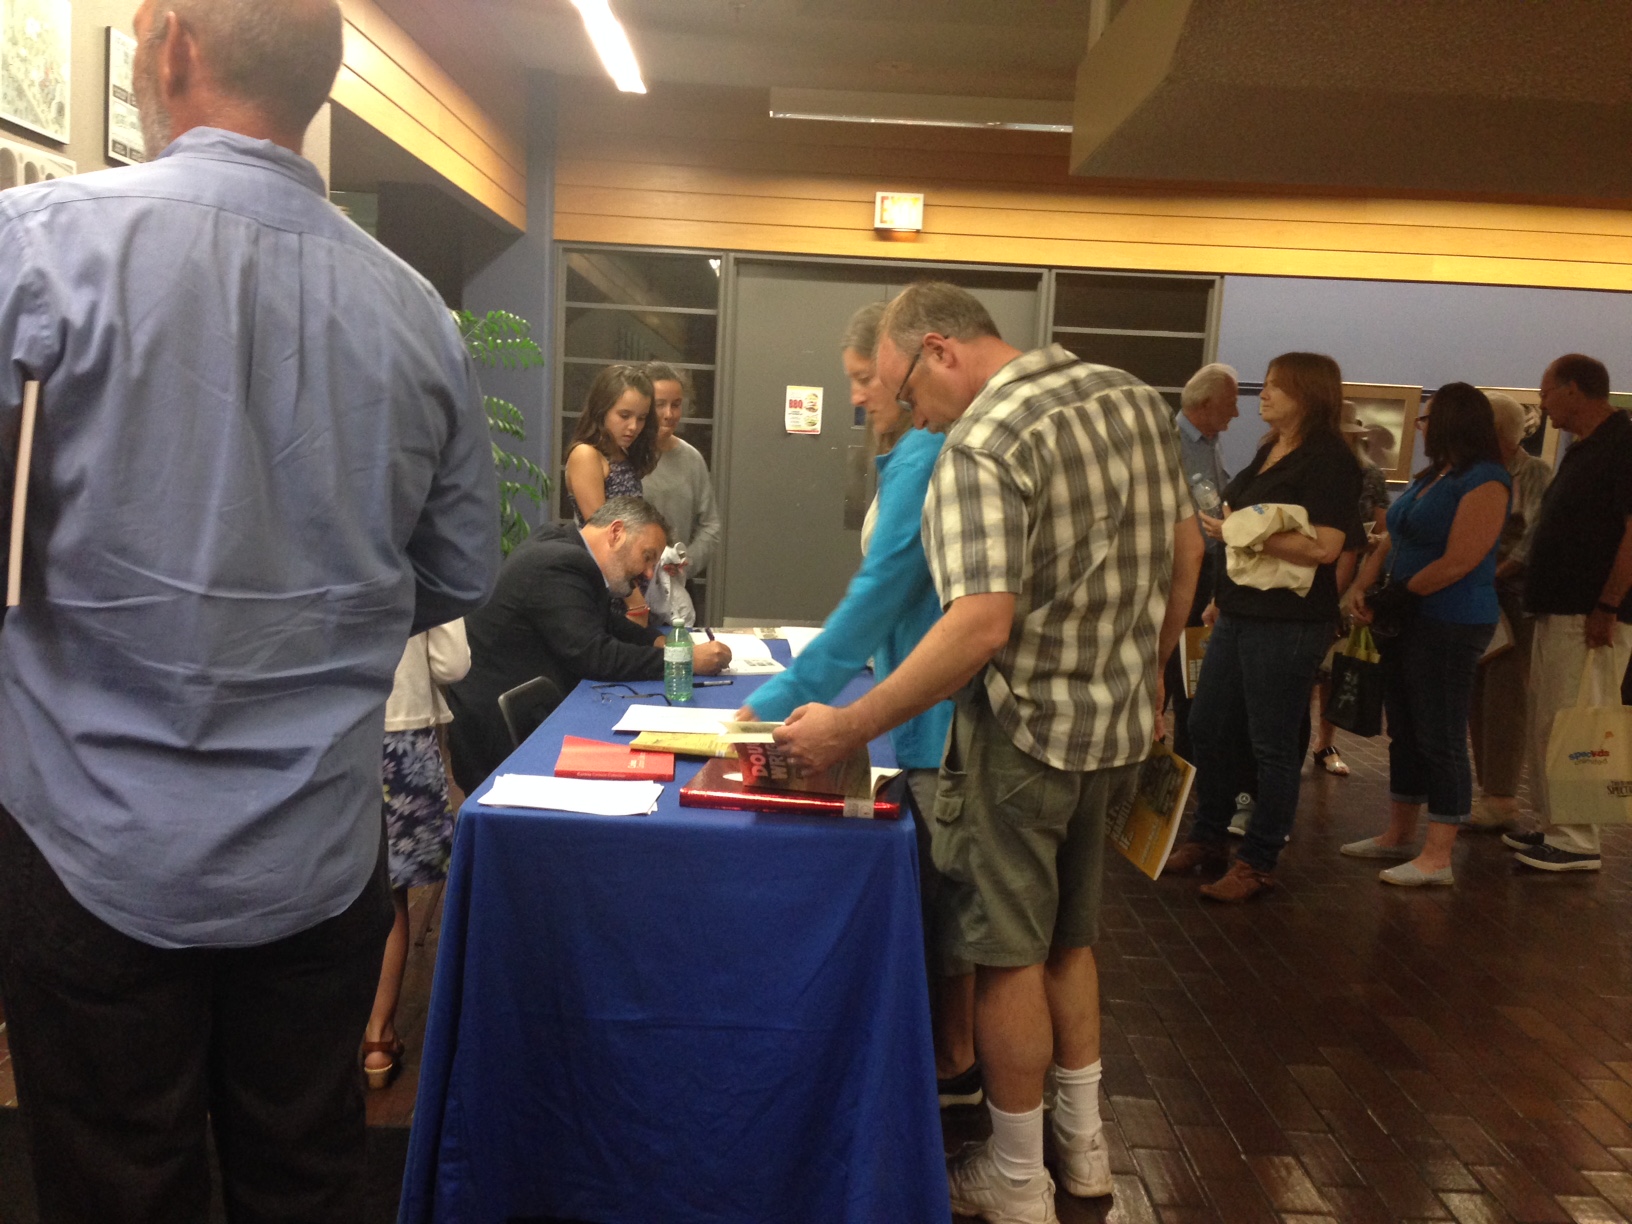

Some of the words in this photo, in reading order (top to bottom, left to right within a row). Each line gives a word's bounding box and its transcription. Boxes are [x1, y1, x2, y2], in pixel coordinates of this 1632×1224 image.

[880, 196, 920, 225] EXT
[789, 399, 803, 409] BBQ
[747, 743, 768, 777] DOU
